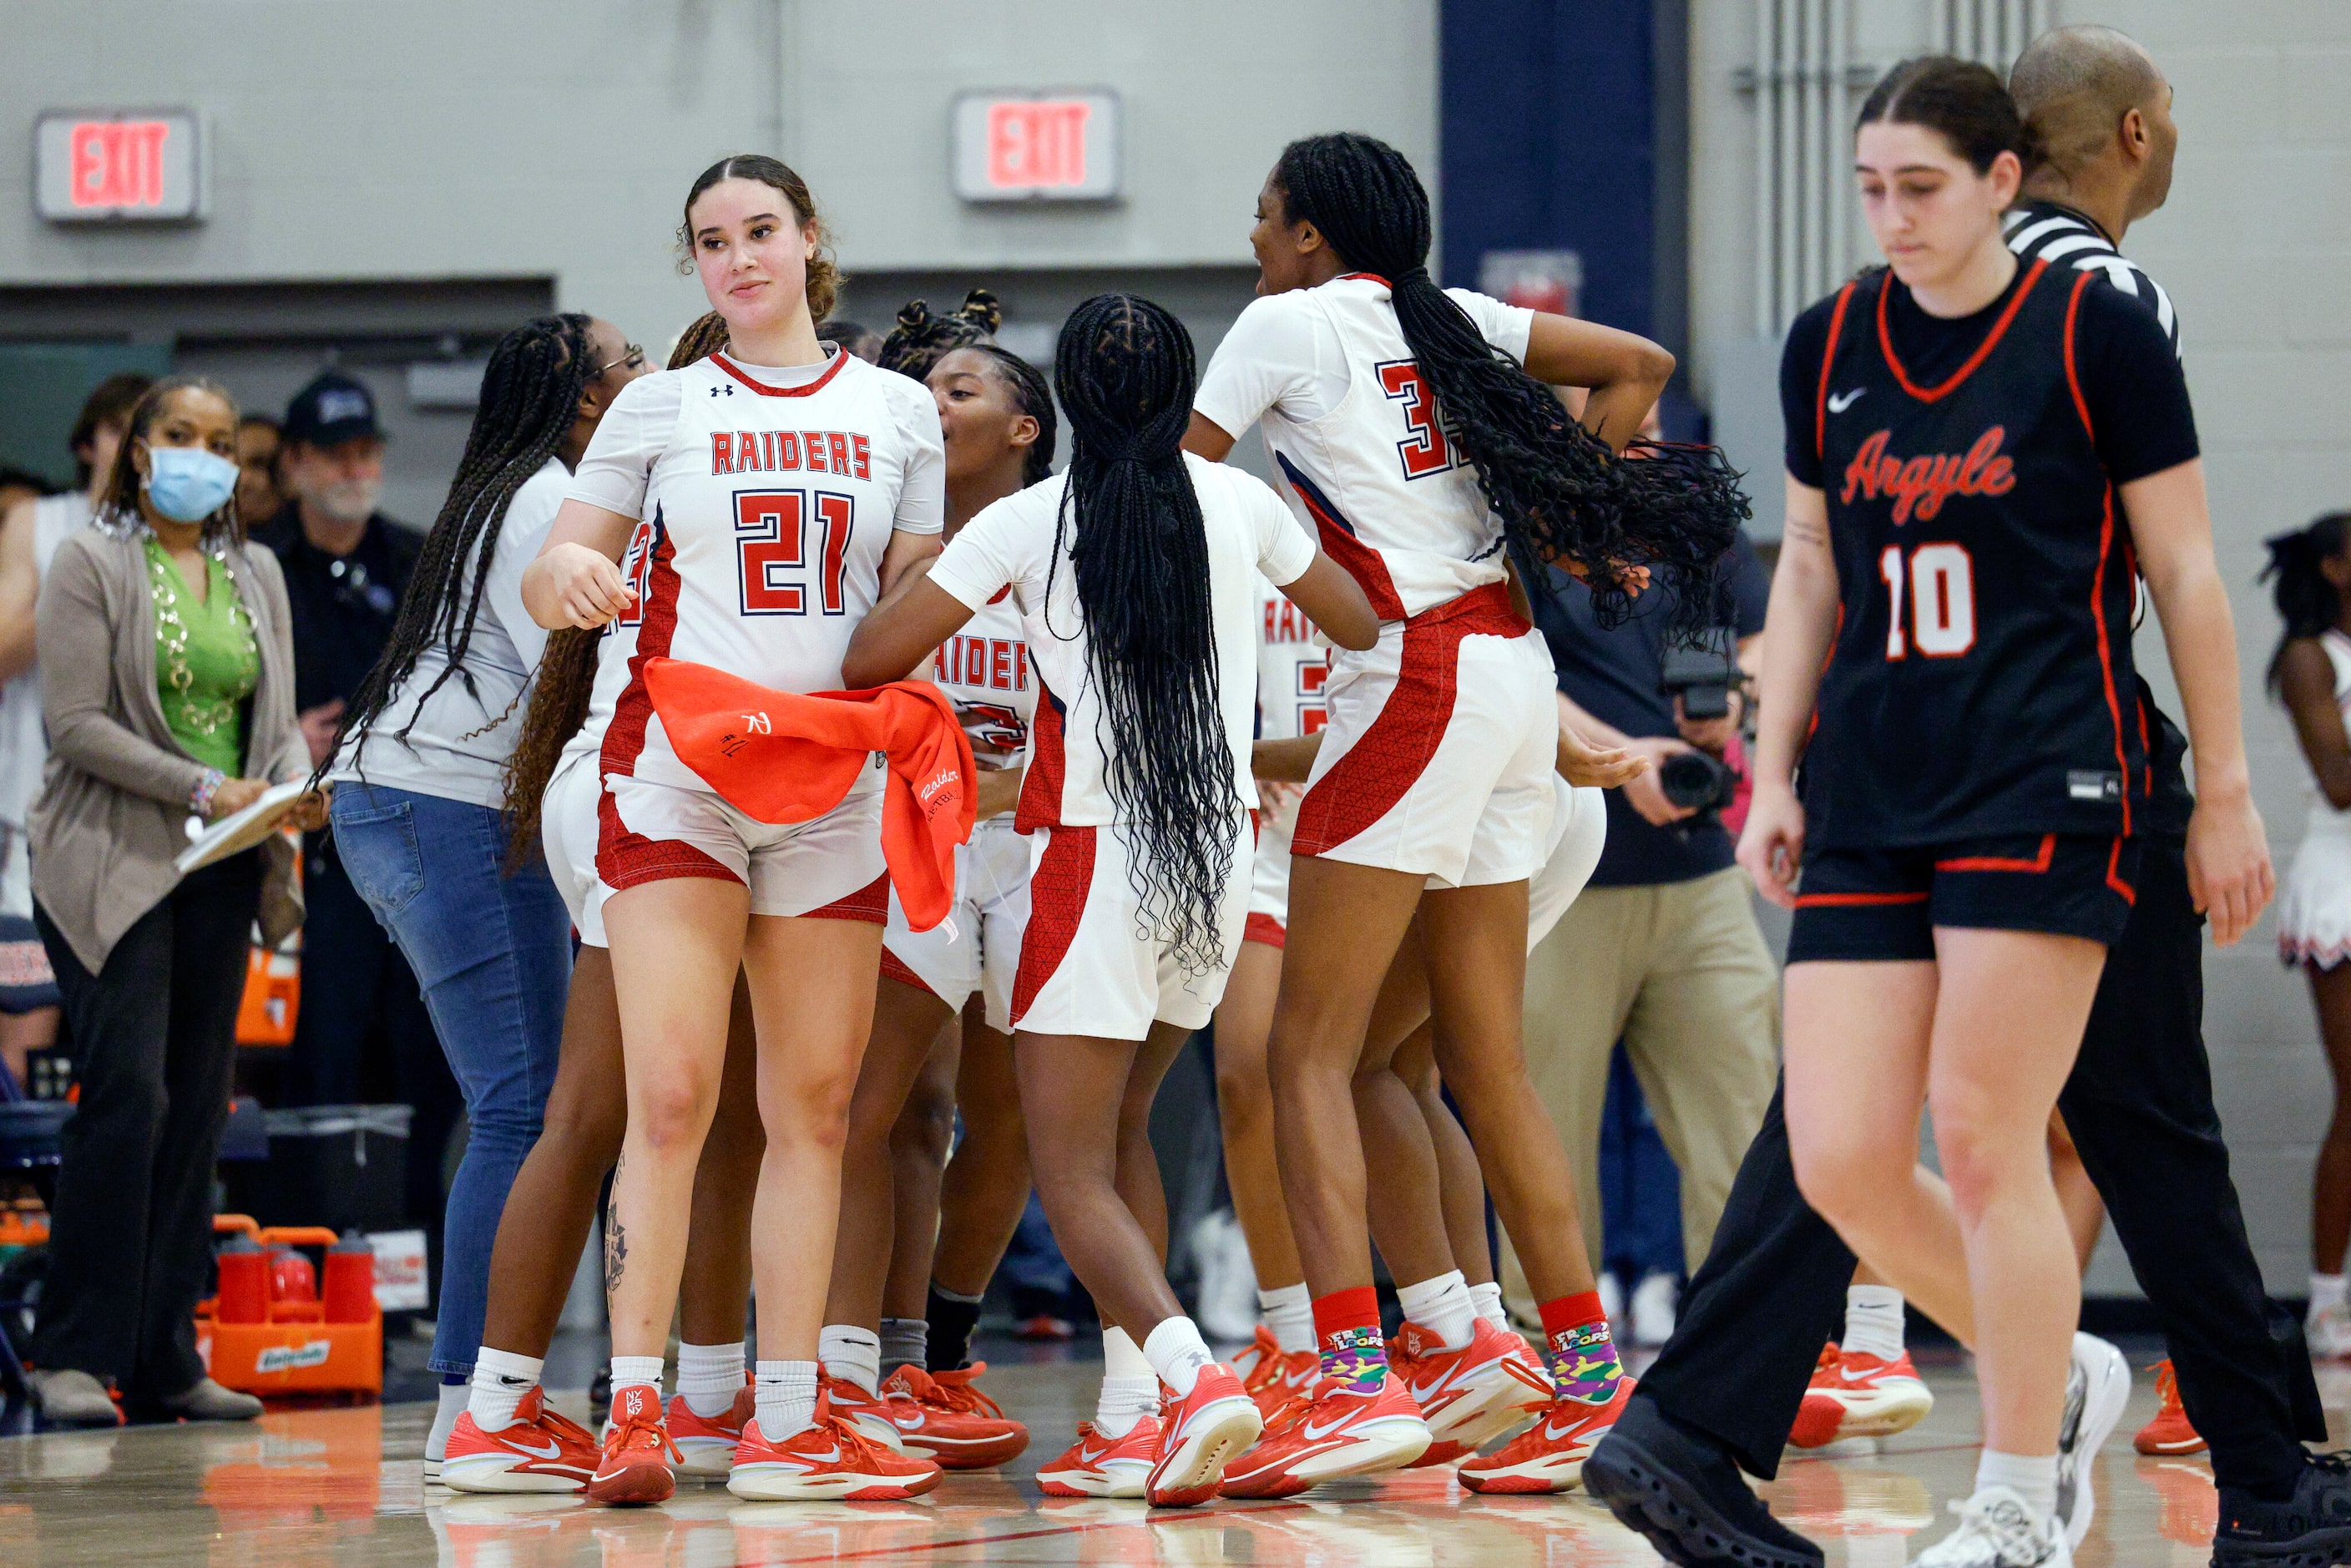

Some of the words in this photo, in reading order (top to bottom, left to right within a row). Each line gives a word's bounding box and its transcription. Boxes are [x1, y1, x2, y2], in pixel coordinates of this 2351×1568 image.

[71, 123, 169, 207] EXIT
[988, 103, 1090, 186] EXIT
[710, 430, 872, 482] RAIDERS
[1840, 424, 2017, 526] Argyle
[732, 488, 854, 616] 21
[1878, 540, 1978, 662] 10
[920, 767, 959, 803] Raider
[1336, 1336, 1385, 1351] LOOPS
[1561, 1330, 1611, 1353] LOOPS
[626, 1389, 643, 1399] NY
[627, 1406, 643, 1415] NY
